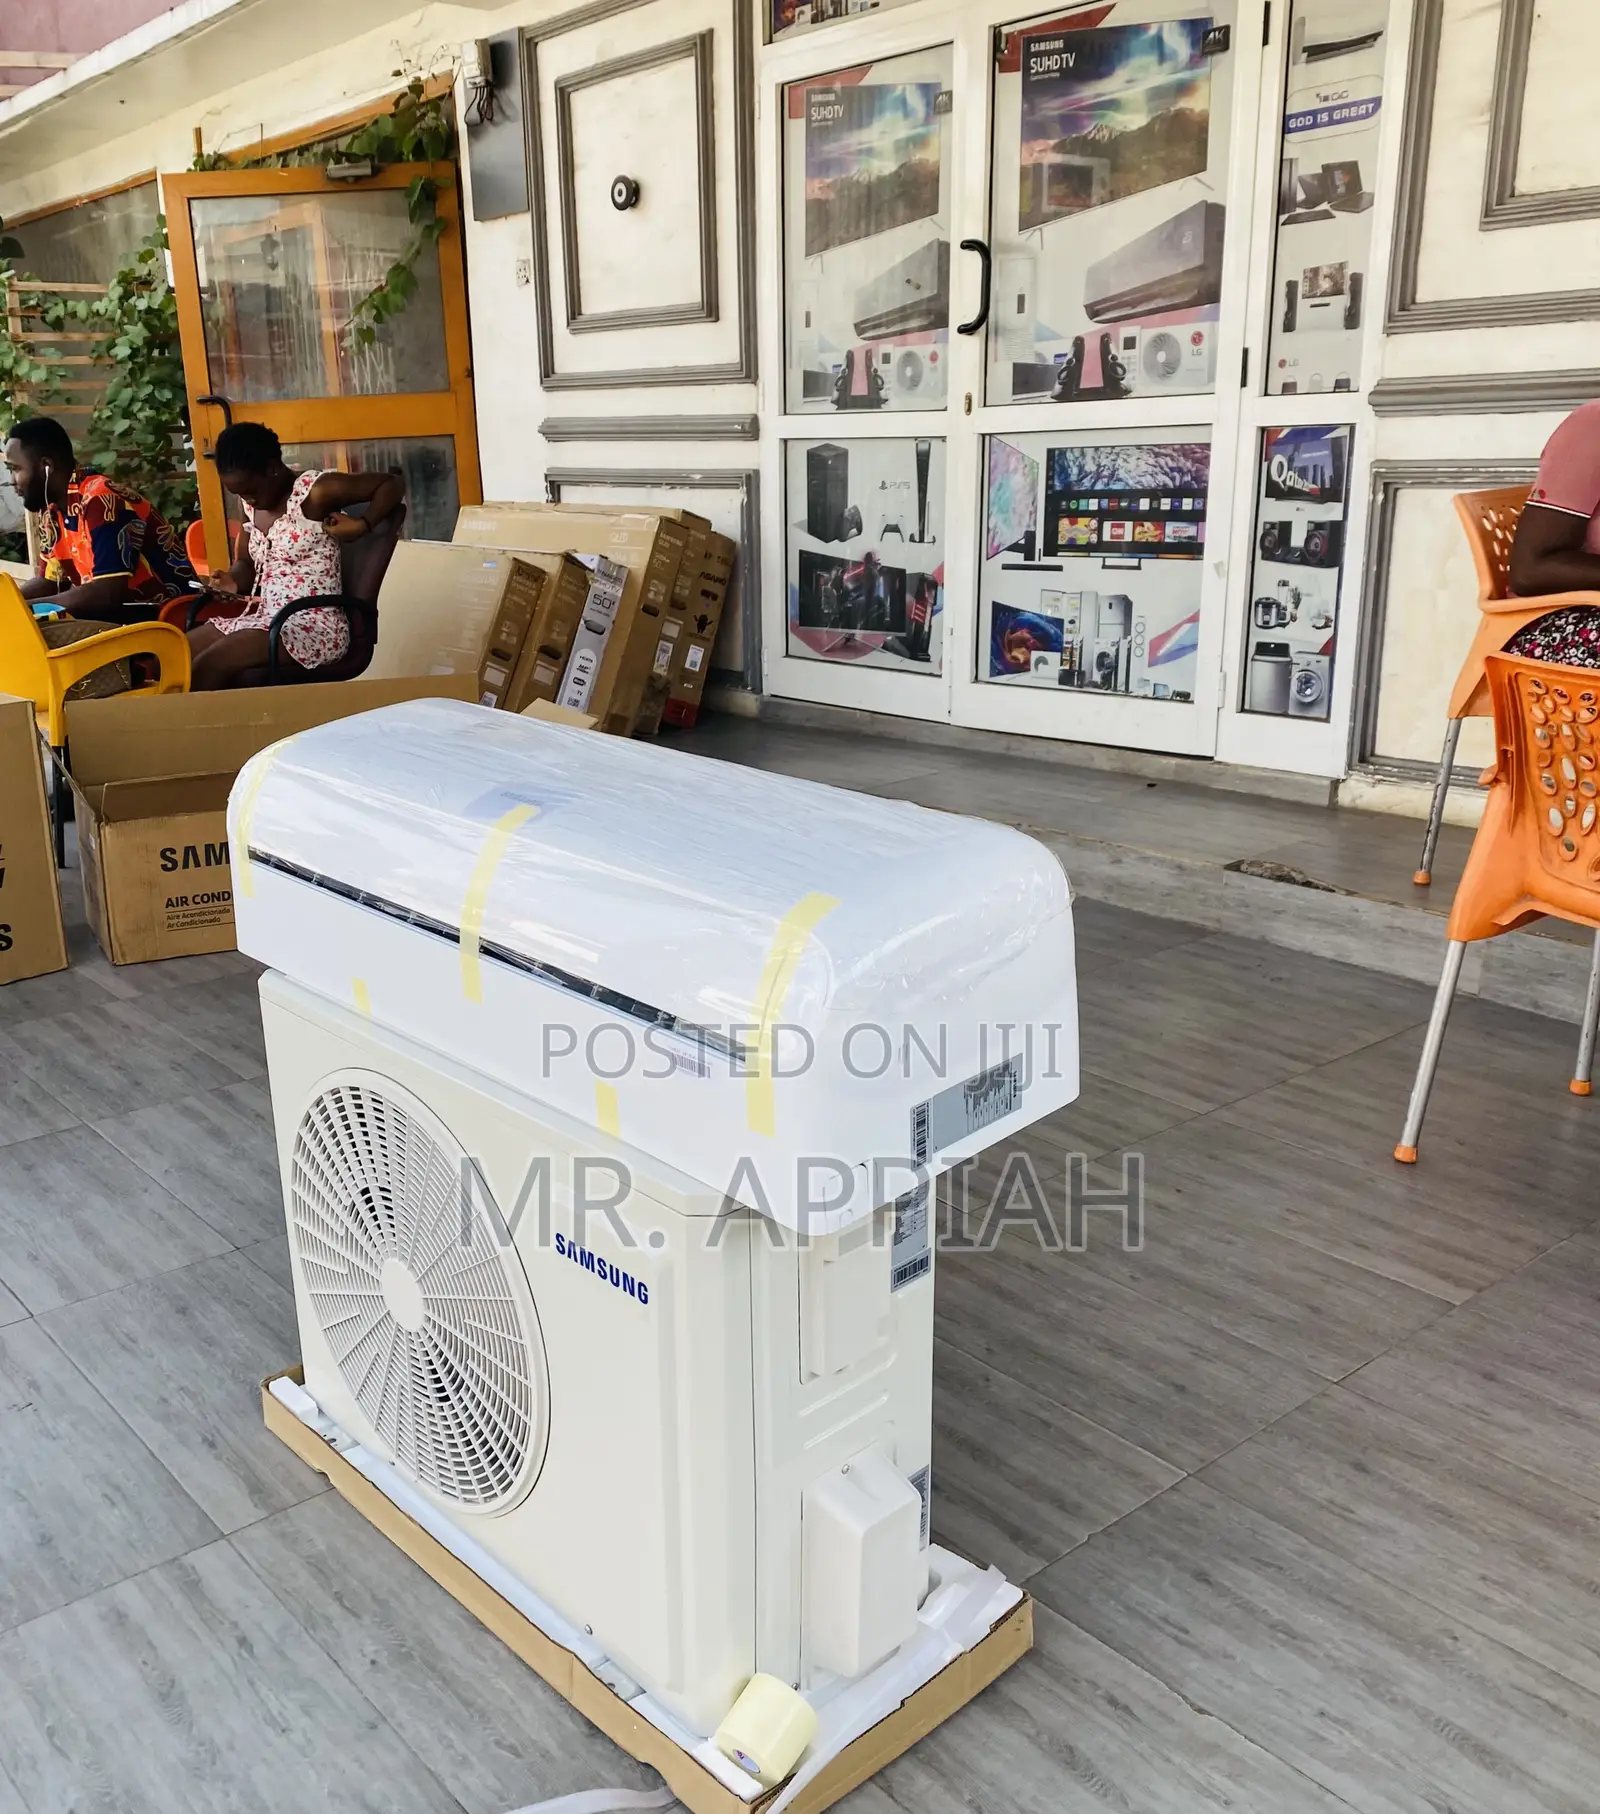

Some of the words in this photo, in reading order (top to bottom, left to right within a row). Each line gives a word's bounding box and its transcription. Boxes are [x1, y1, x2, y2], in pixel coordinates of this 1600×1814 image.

[1030, 39, 1064, 52] SAMSUNG
[1289, 115, 1313, 128] GOD
[1317, 112, 1329, 124] IS
[1333, 103, 1375, 120] GREAT
[165, 895, 190, 909] AIR
[166, 913, 181, 921] Aire
[181, 907, 231, 919] Acondicionado
[175, 916, 221, 928] Condicionado
[555, 1232, 648, 1305] SAMSUNG
